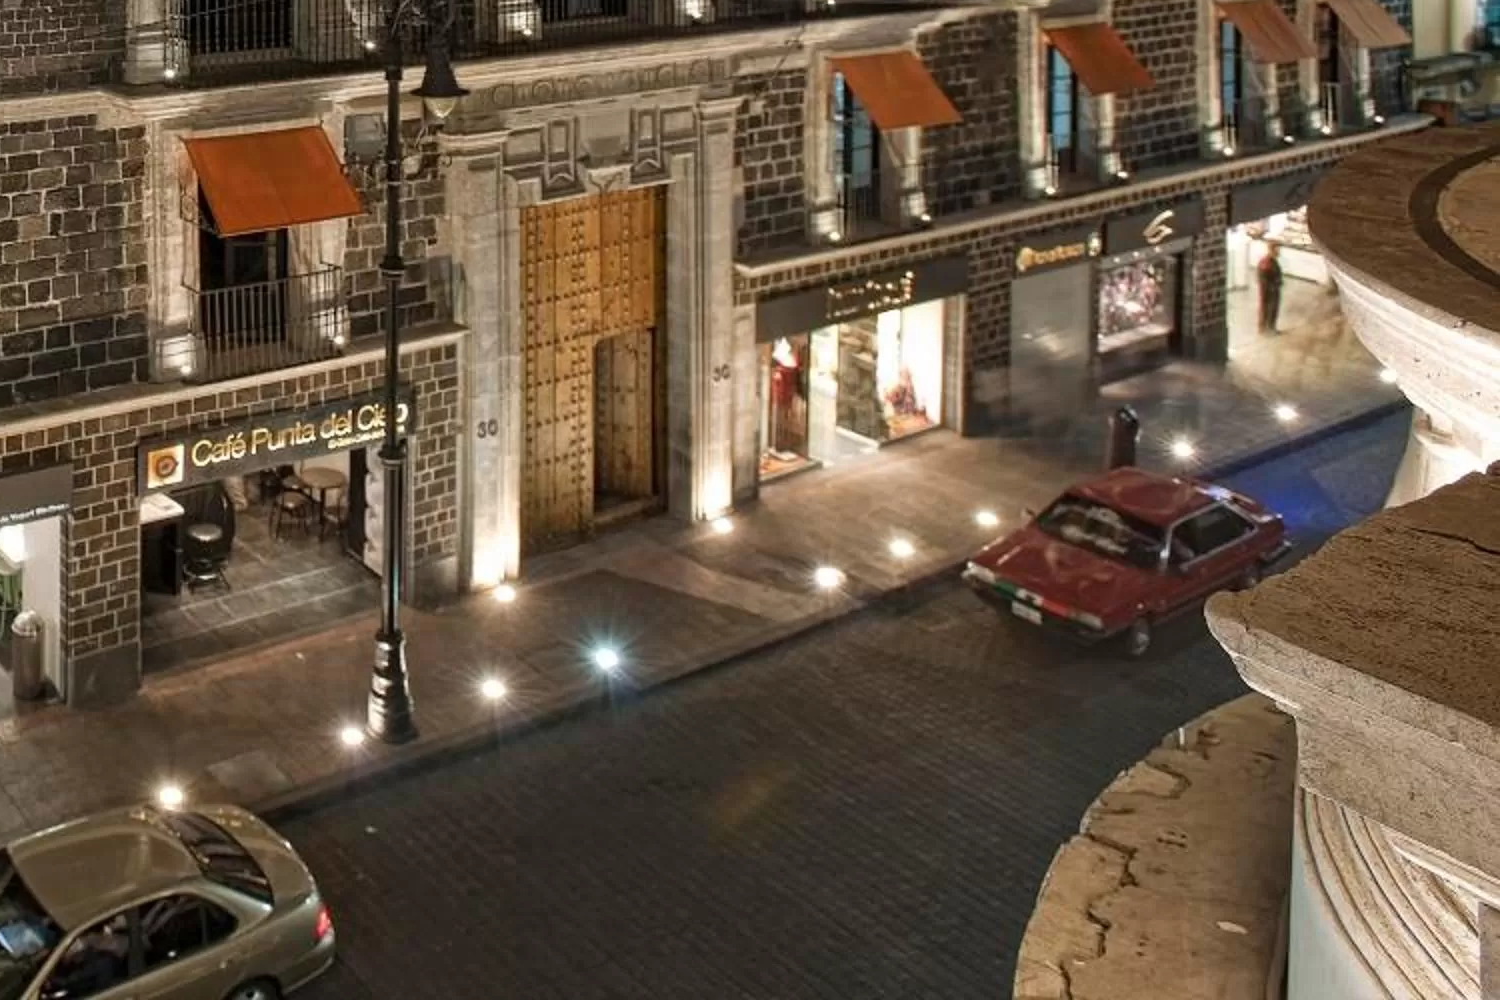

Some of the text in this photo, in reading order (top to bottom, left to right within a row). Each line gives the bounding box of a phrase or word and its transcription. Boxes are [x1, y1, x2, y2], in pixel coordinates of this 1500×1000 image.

[191, 431, 247, 467] Café
[251, 420, 317, 456] Punta
[320, 409, 353, 439] del
[477, 418, 499, 439] 30
